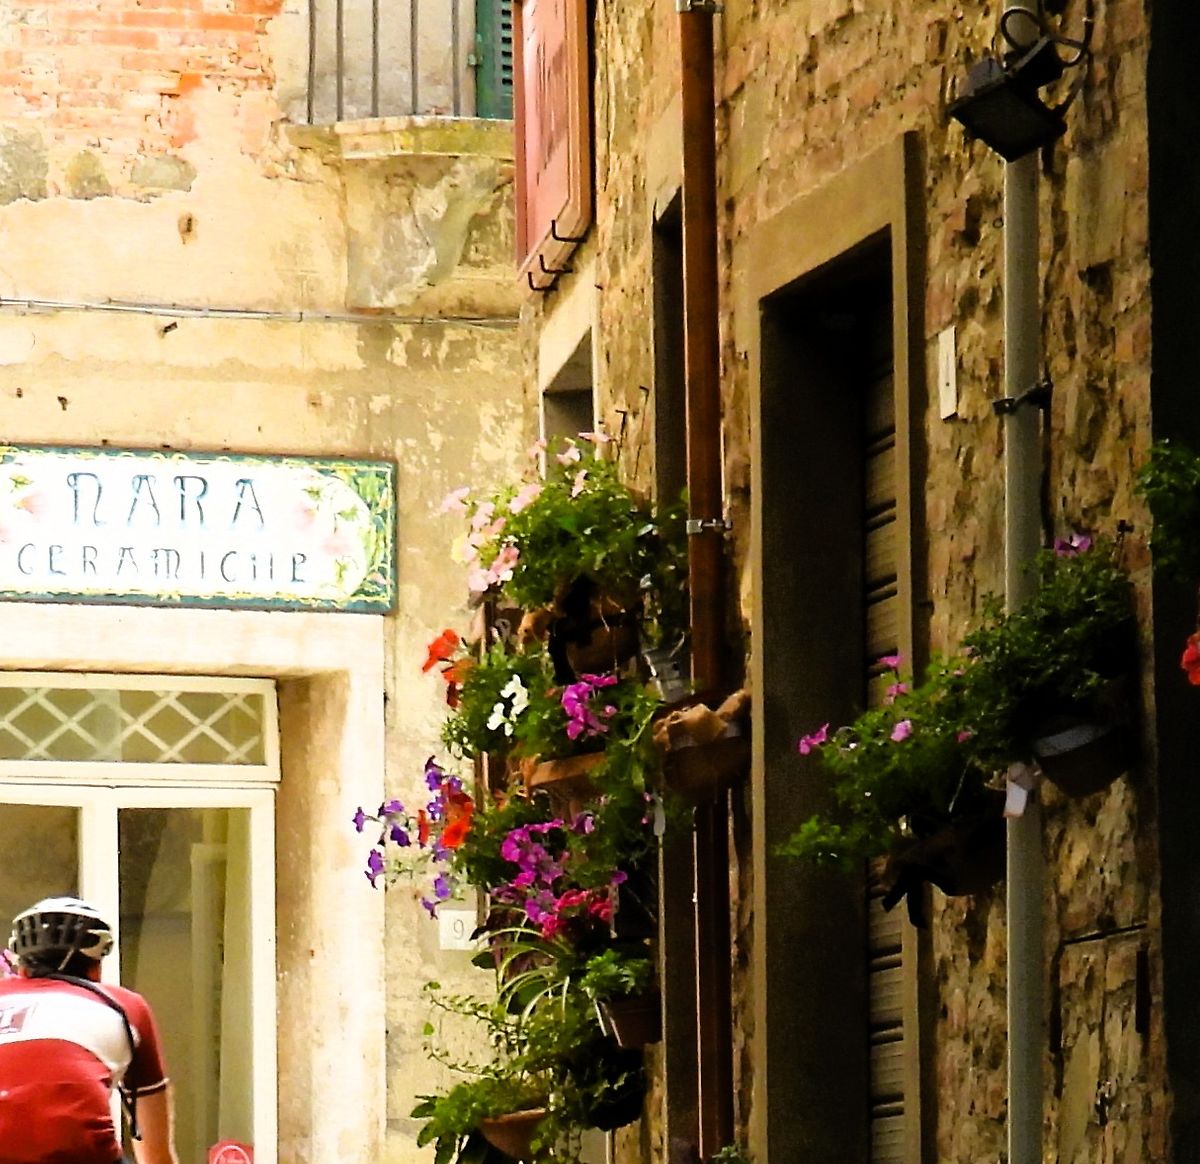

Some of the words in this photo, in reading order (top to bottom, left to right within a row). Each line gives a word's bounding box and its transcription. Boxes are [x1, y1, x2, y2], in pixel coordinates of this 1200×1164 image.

[66, 472, 265, 530] NARA
[17, 543, 309, 584] CERAMICHE
[452, 918, 465, 940] 9
